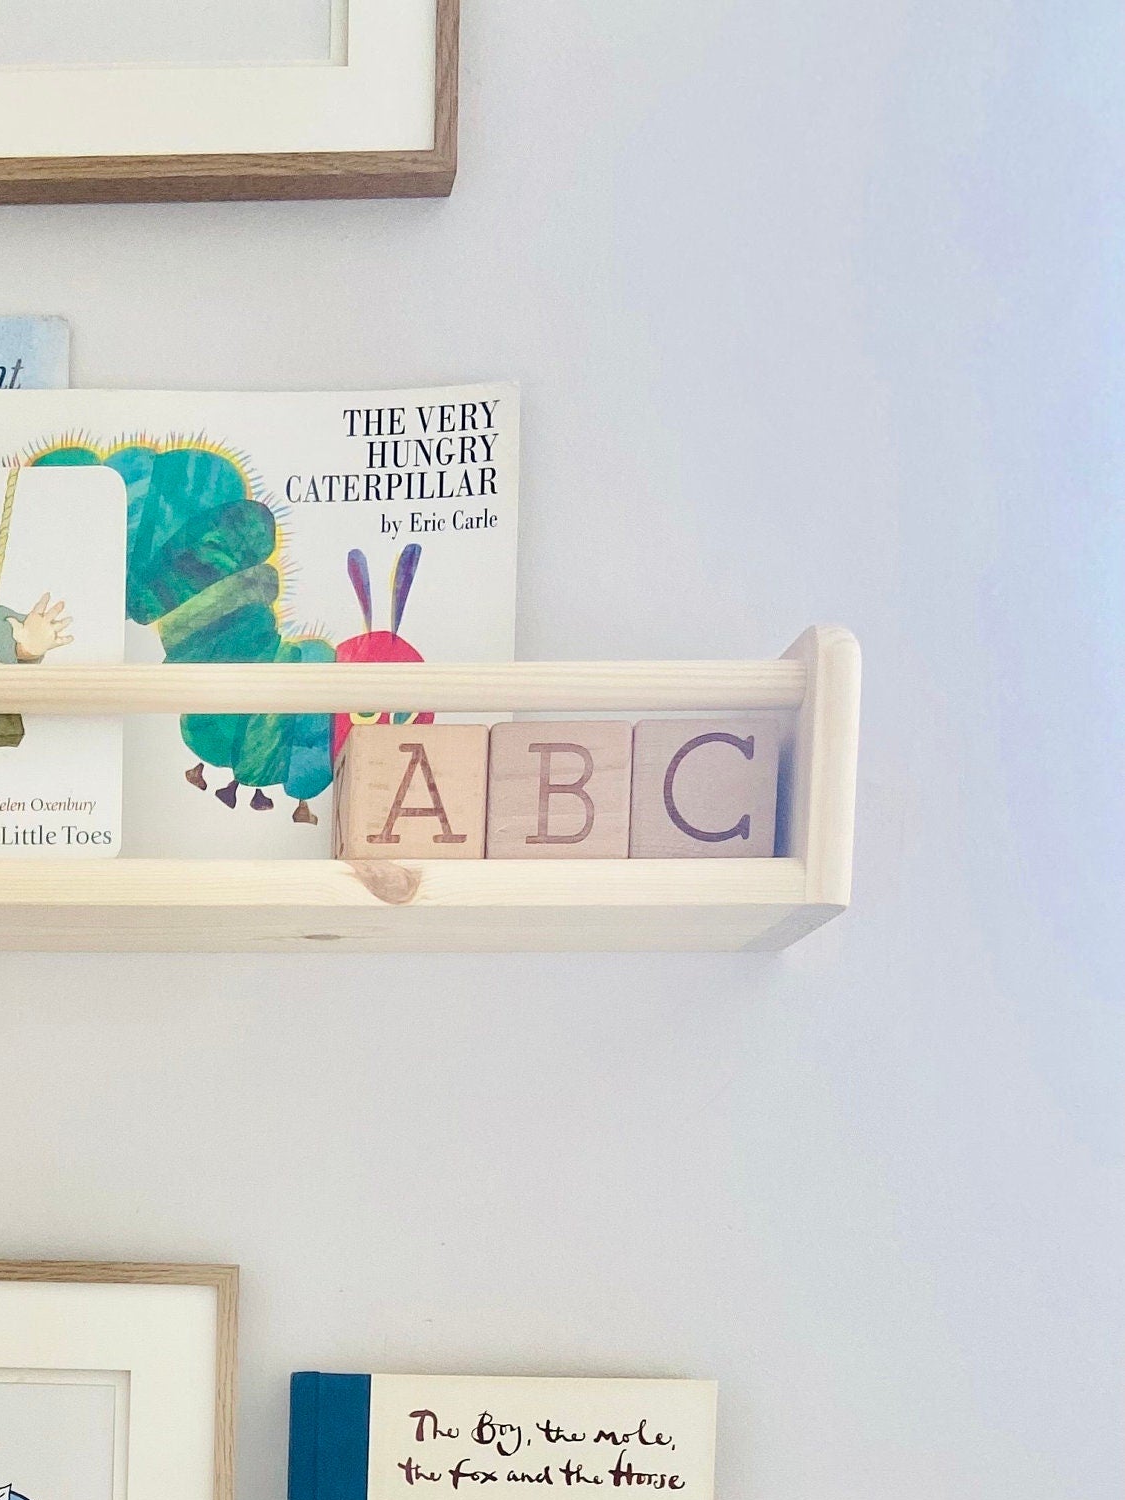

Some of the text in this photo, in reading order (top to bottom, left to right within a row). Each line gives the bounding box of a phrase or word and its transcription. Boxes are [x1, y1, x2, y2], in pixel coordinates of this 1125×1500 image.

[342, 399, 501, 437] THE VERY
[365, 433, 499, 469] HUNGRY
[285, 465, 498, 503] CATERPILLAR
[381, 507, 498, 540] by Eric Carle
[30, 797, 97, 815] Oxenbury
[1, 824, 57, 845] Little
[61, 825, 112, 845] Toes
[408, 1409, 676, 1457] The Boy, the mole,
[397, 1449, 687, 1490] the fox and the Horse
